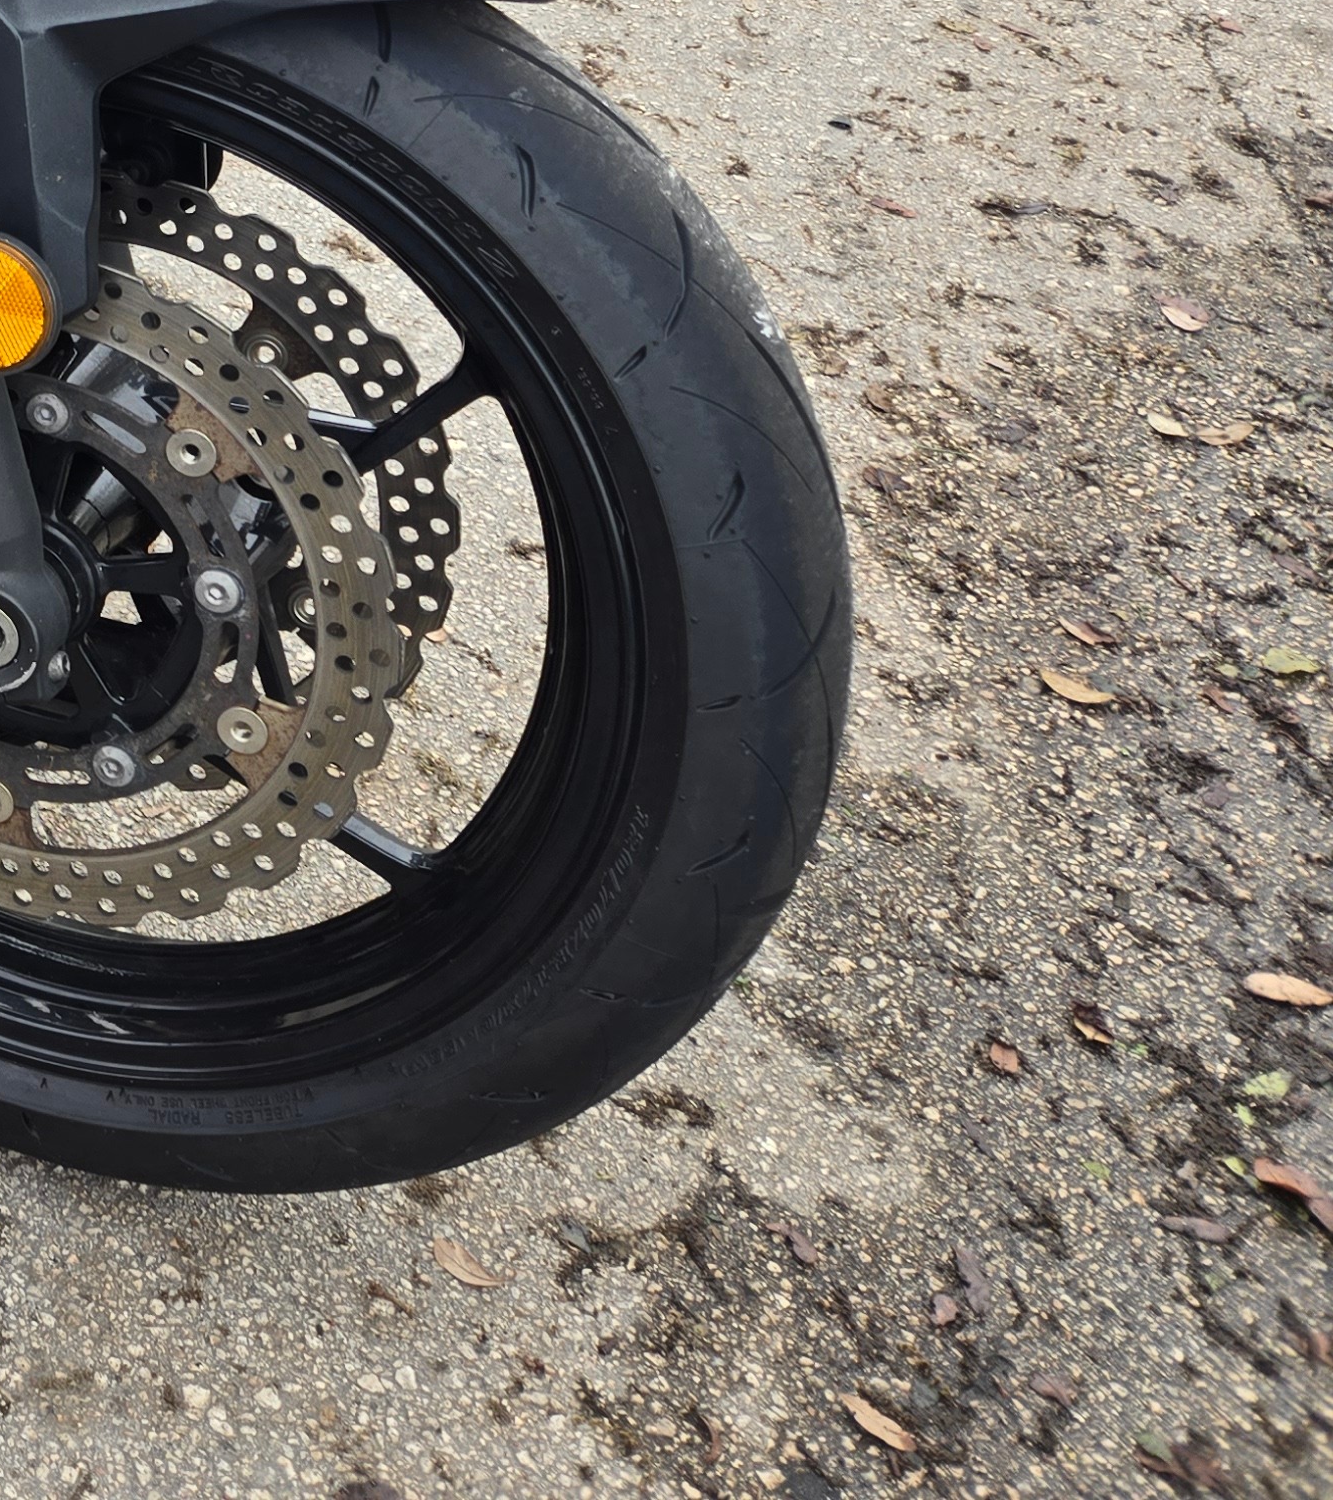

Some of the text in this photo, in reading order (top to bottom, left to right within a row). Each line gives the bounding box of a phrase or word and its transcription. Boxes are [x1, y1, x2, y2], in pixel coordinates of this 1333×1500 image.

[190, 55, 519, 277] Roadsport 2
[161, 1097, 184, 1108] USE
[190, 1097, 226, 1108] WHEEL
[234, 1093, 270, 1107] FRONT
[148, 1103, 303, 1125] TUBELESS RADIAL
